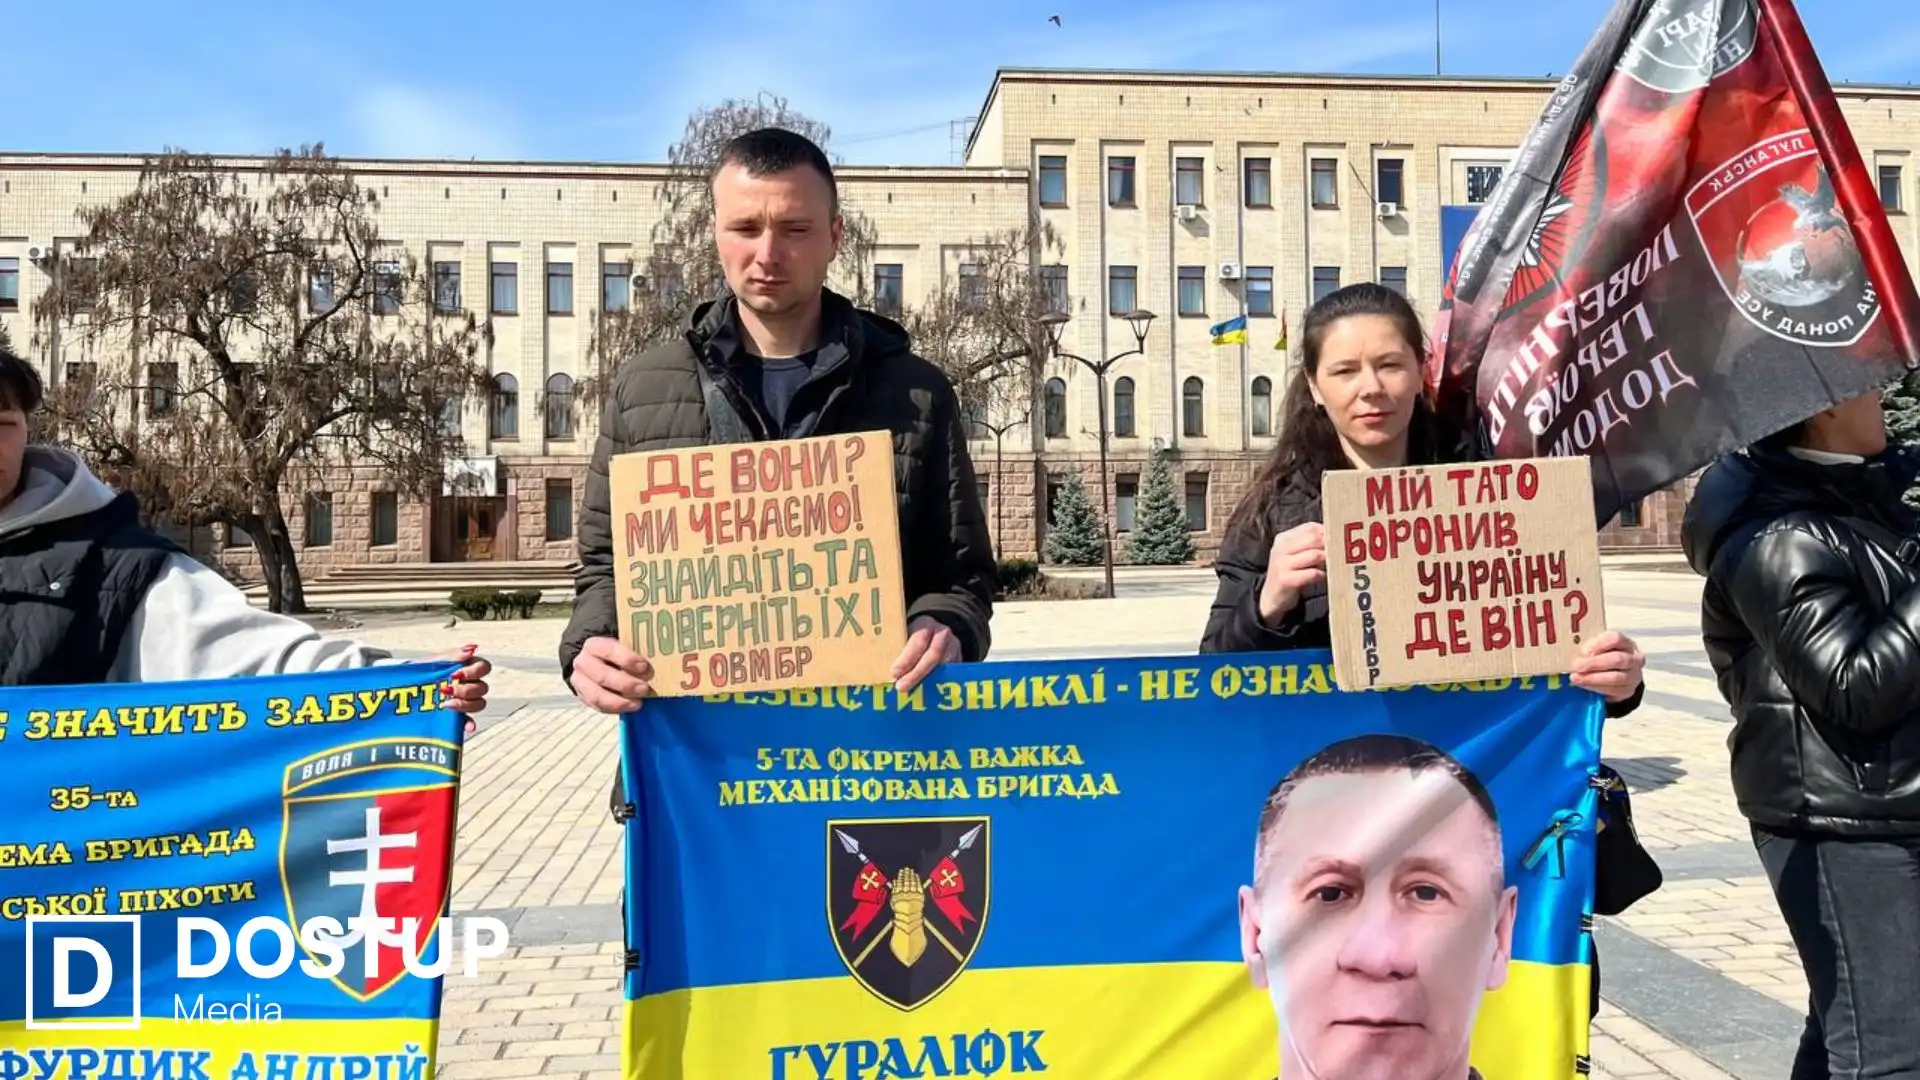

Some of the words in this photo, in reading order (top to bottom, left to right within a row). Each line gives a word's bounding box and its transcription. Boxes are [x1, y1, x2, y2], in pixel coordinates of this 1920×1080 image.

[640, 452, 714, 504] ДЕ
[731, 436, 865, 494] ВОНИ?
[1366, 469, 1432, 517] МІЙ
[1447, 463, 1538, 506] ТАТО
[625, 506, 678, 557] МИ
[689, 484, 864, 546] ЧЕКАЄМО!
[1343, 511, 1519, 564] БОРОНИВ
[814, 539, 878, 588] ТА
[1417, 549, 1581, 603] УКРАЇНУ.
[631, 595, 812, 658] ПОВЕРНІТЬ
[815, 587, 883, 638] ЇХ!
[1405, 609, 1471, 659] ДЕ
[680, 653, 700, 690] 5
[709, 646, 812, 689] ОВМБР
[936, 667, 1106, 711] ЗНИКЛІ
[1140, 668, 1200, 701] НЕ
[24, 702, 248, 740] ЗНАЧИТЬ
[302, 752, 352, 780] ВОЛЯ
[395, 745, 447, 765] ЧЕСТЬ
[756, 747, 821, 771] 5-ТА
[828, 747, 962, 772] ОКРЕМА
[970, 744, 1085, 769] ВАЖКА
[718, 774, 970, 807] МЕХАНІЗОВАНА
[977, 772, 1121, 800] БРИГАДА
[85, 828, 255, 862] БРИГАДА
[118, 881, 256, 913] ПІХОТИ
[0, 1049, 212, 1080] ФУРДИК
[231, 1043, 430, 1080] АНДРІЙ
[768, 1028, 1048, 1080] ГУРАЛЮК
